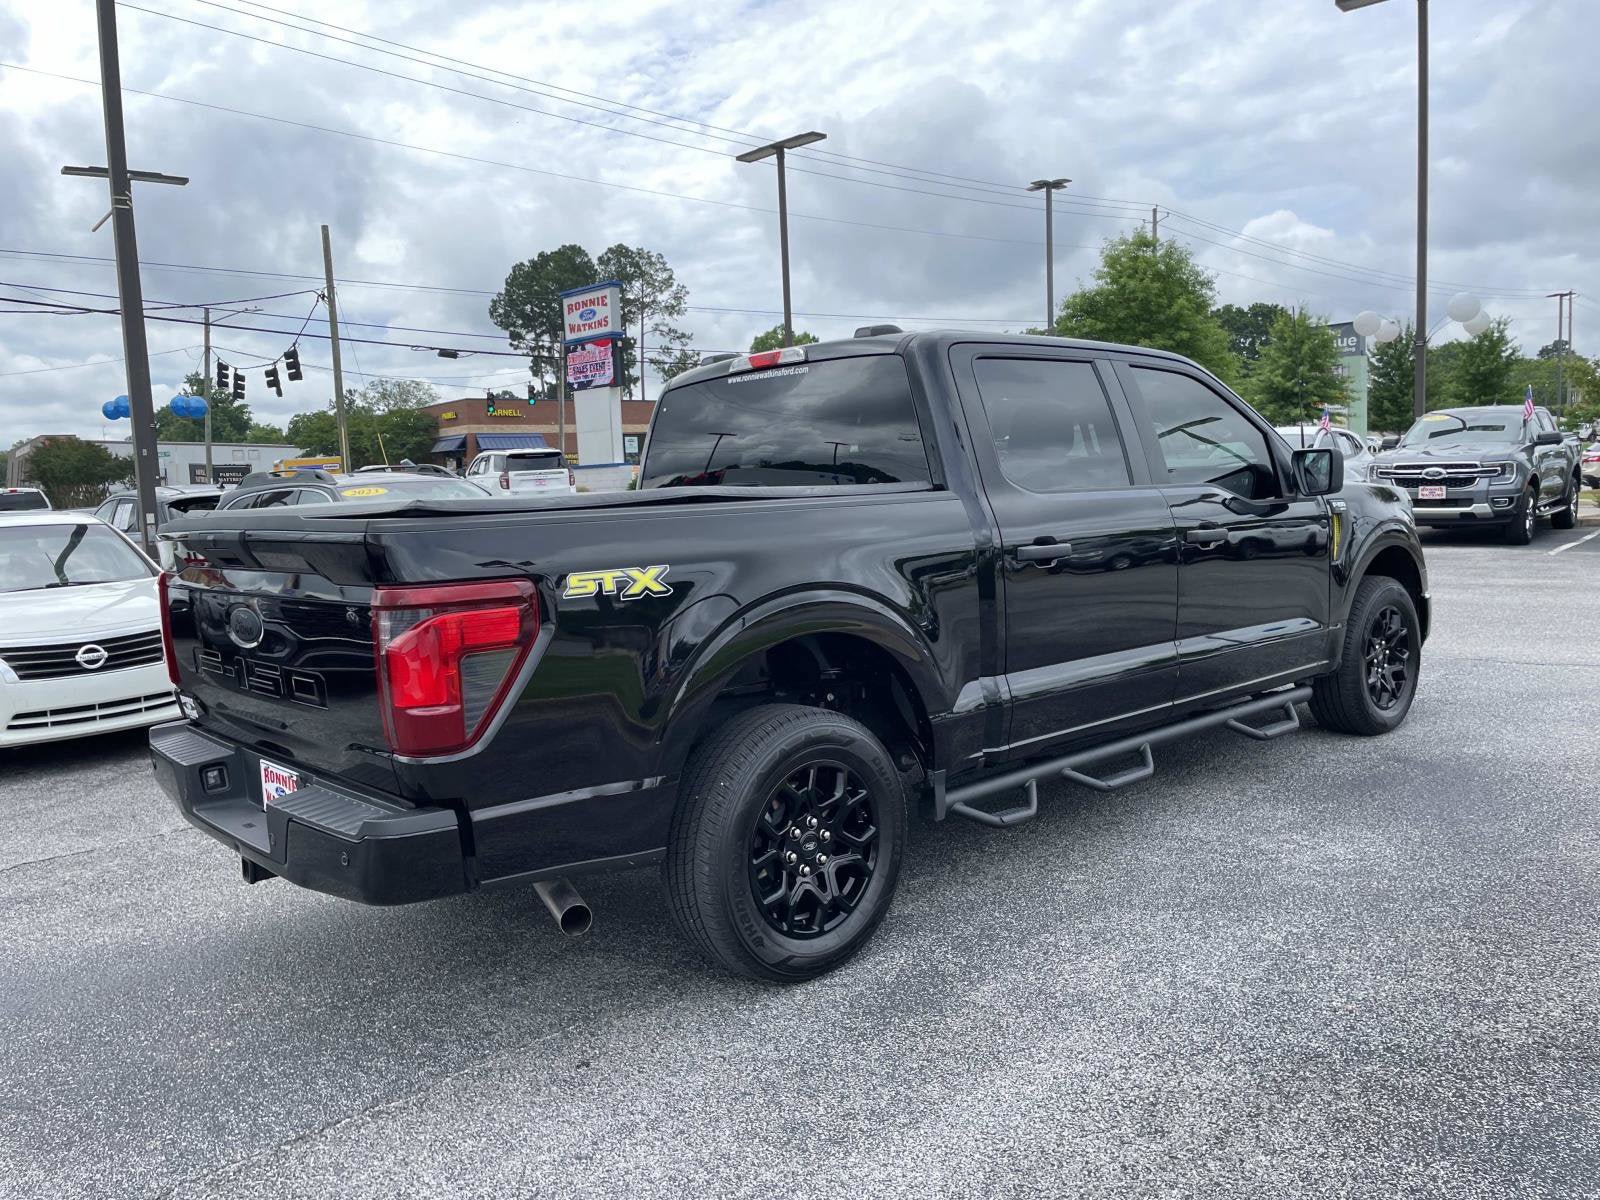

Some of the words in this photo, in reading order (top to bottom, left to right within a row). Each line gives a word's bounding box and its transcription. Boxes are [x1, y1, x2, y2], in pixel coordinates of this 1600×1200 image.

[567, 295, 608, 315] RONNIE
[568, 316, 609, 334] WATKINS
[728, 366, 809, 384] www.ronniewatkinsford.com
[563, 565, 674, 600] STX
[193, 646, 330, 711] F-150
